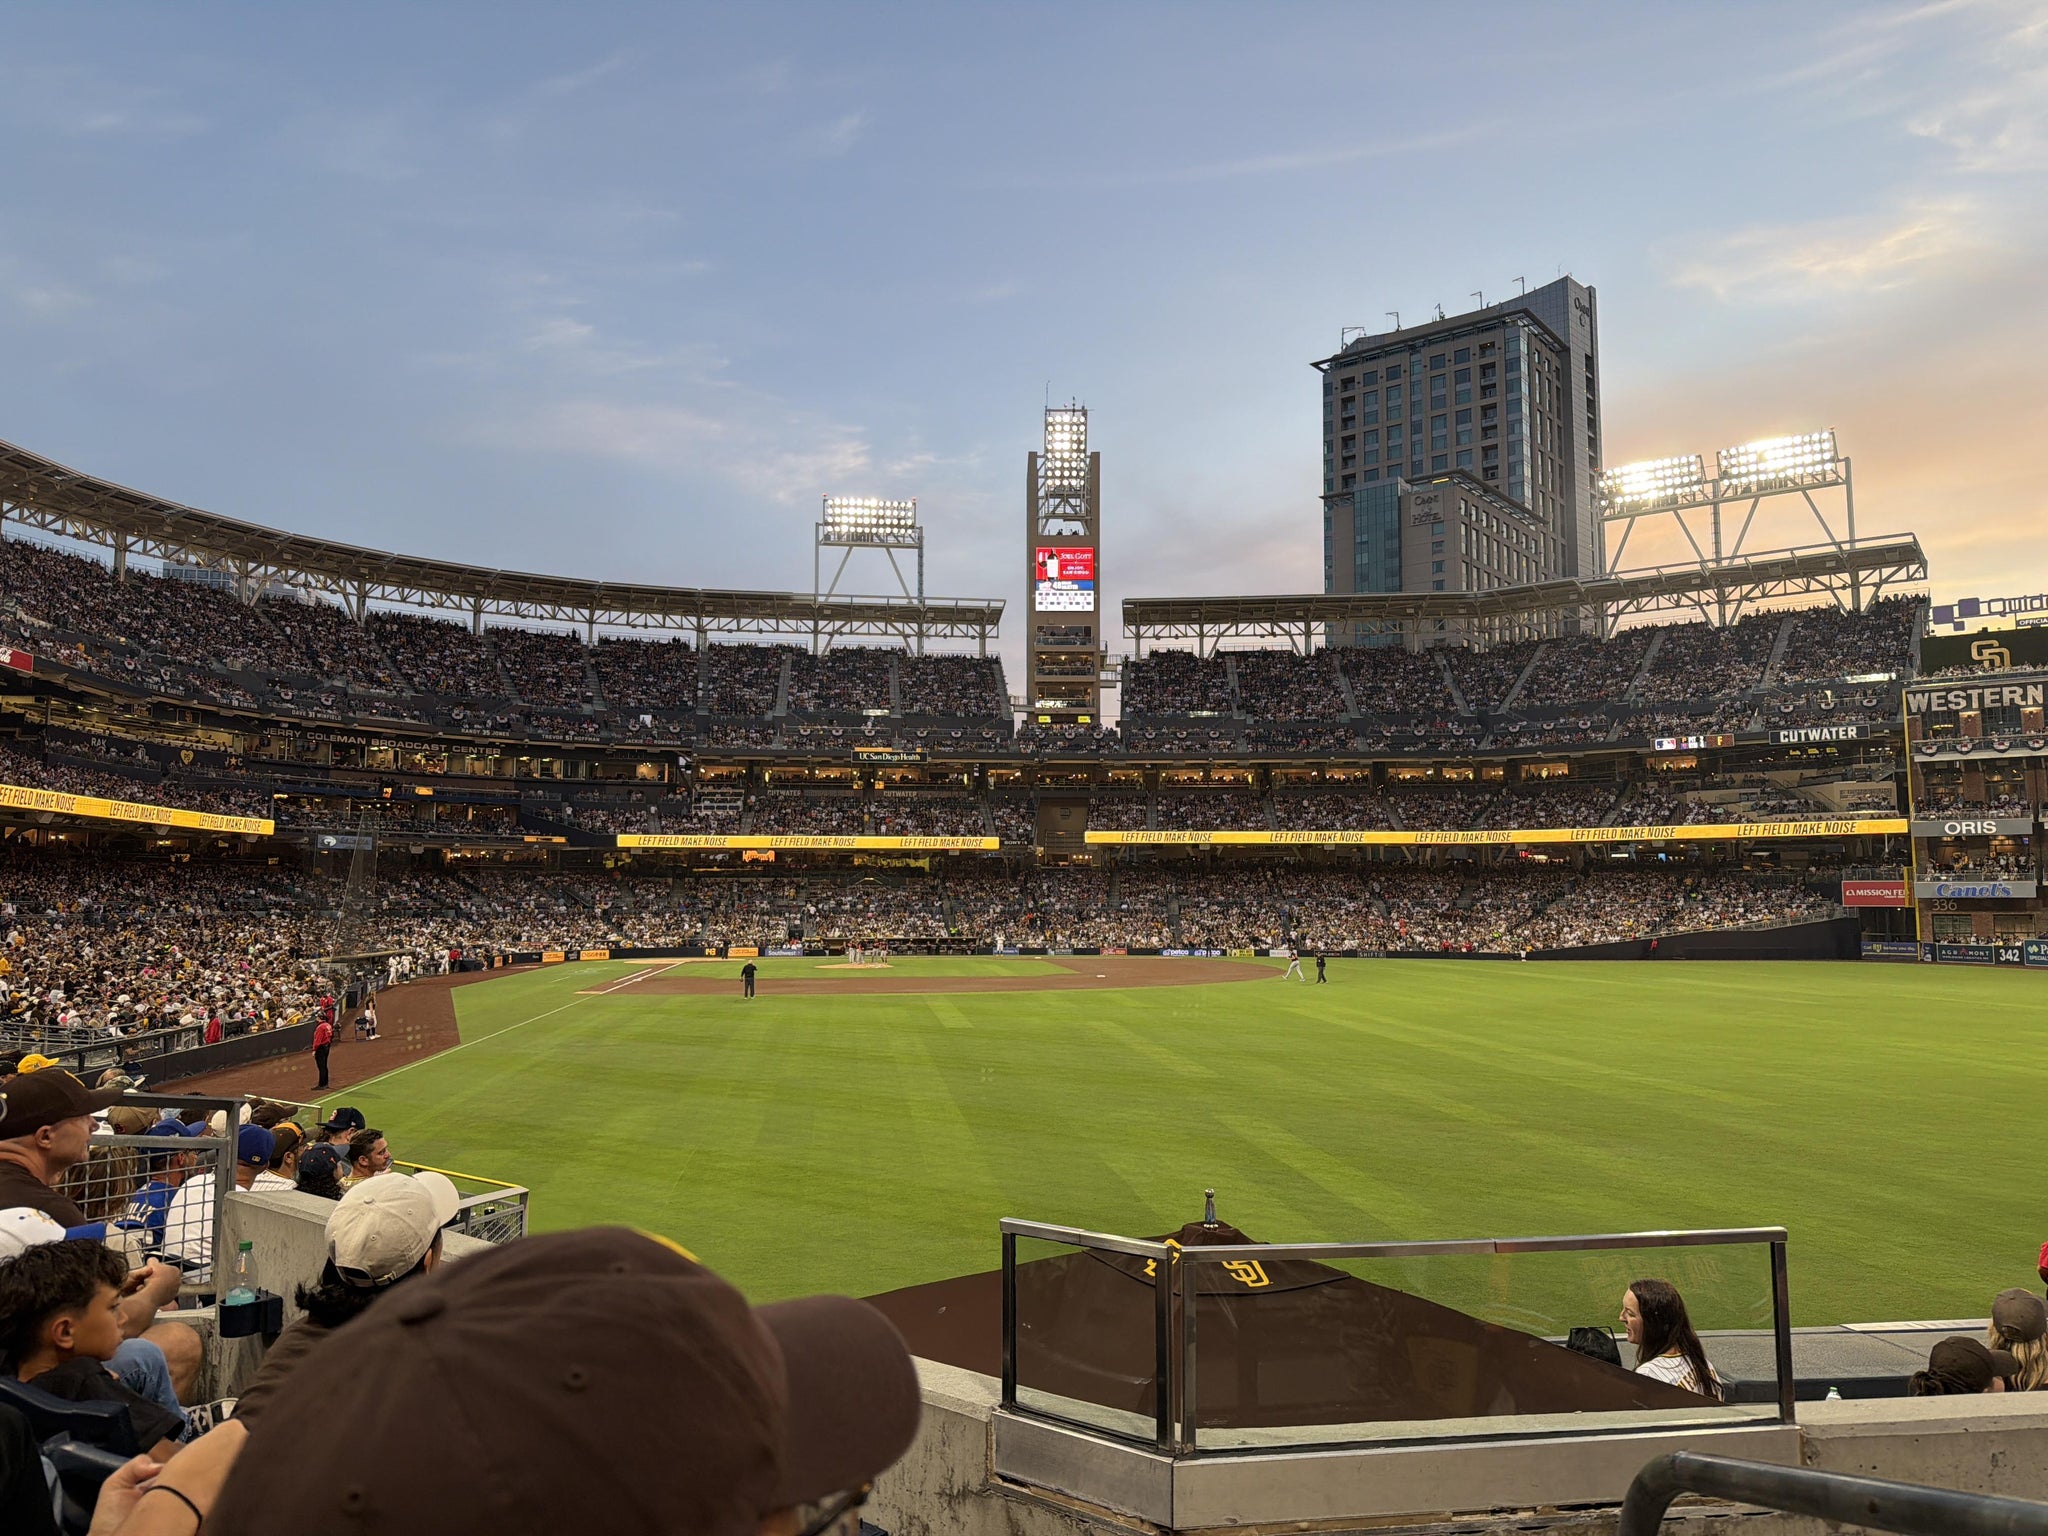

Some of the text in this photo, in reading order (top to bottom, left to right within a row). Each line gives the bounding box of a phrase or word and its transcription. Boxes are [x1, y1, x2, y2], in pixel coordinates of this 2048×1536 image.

[1906, 684, 2044, 713] WESTERN
[316, 713, 341, 721] WINFIELD
[263, 727, 501, 755] JERRY COLEMAN BROADCAST CENTER
[1780, 726, 1858, 743] CUTWATER
[91, 737, 107, 747] RAK
[882, 753, 899, 762] Diego
[900, 753, 921, 761] Health
[13, 788, 34, 805] FIELD
[34, 792, 56, 808] MAKE
[55, 794, 76, 811] NOISE
[110, 802, 172, 823] LEFT FIELD MAKE NOISE
[199, 814, 261, 832] LEFT FIELD MAKE NOISE
[1737, 822, 1856, 836] LEFT FIELD MAKE NOISE
[1944, 821, 1997, 835] ORIS
[1121, 833, 1213, 842] LEFT FIELD MAKE NOISE
[1270, 833, 1364, 842] LEFT FIELD MAKE NOISE
[1415, 832, 1512, 842] LEFT FIELD MAKE NOISE
[1571, 827, 1676, 840] LEFT FIELD MAKE NOISE
[638, 836, 728, 846] LEFT FIELD MAKE NOISE
[770, 837, 856, 846] LEFT FIELD MAKE NOISE
[900, 838, 983, 847] LEFT FIELD MAKE NOISE
[1936, 884, 2012, 898] Canel's
[1932, 899, 1958, 911] 336
[2000, 949, 2020, 962] 342
